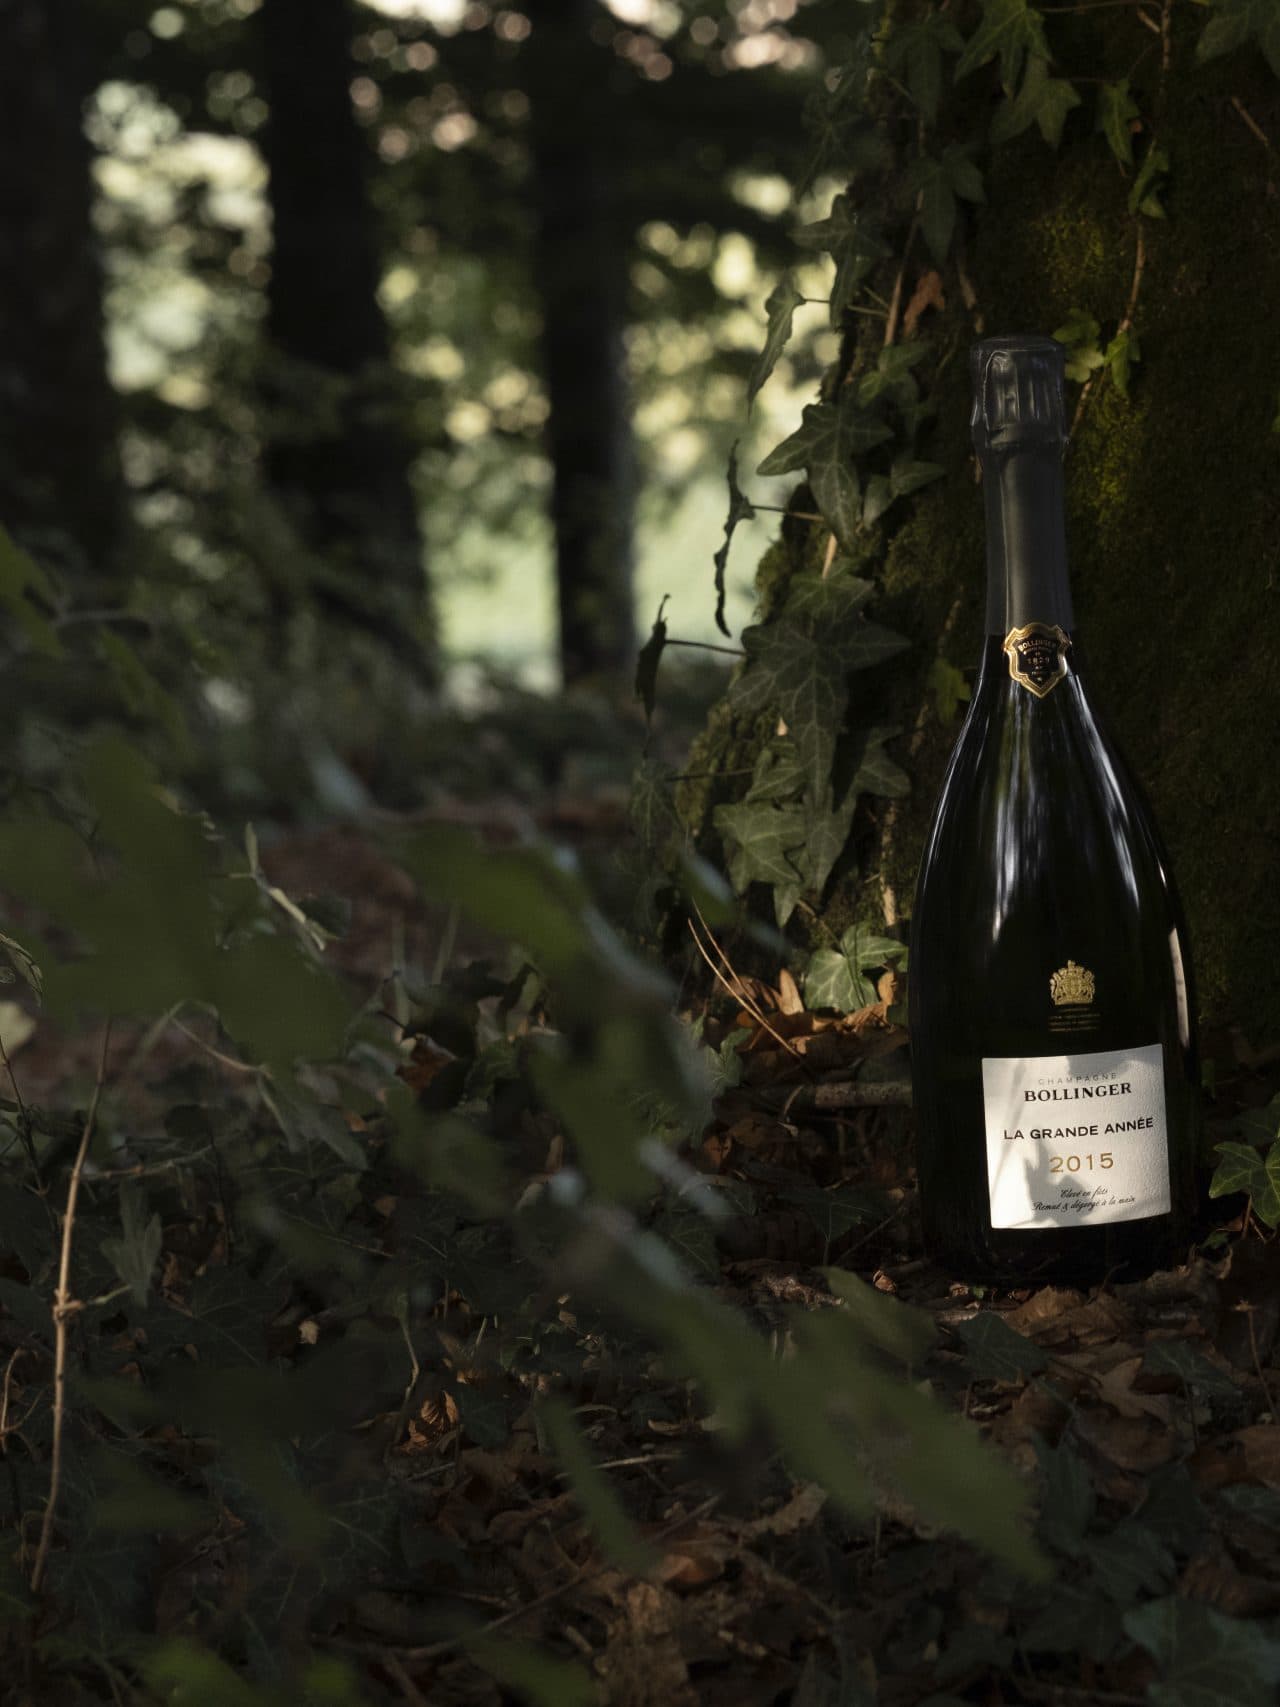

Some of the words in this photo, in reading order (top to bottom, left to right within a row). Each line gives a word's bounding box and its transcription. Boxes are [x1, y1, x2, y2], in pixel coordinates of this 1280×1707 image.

[1038, 1072, 1118, 1085] CHAMPAGNE
[1024, 1082, 1132, 1102] BOLLINGER
[1004, 1129, 1024, 1140] LA
[1030, 1125, 1099, 1140] GRANDE
[1104, 1117, 1154, 1134] ANNÉE
[1050, 1152, 1114, 1173] 2015
